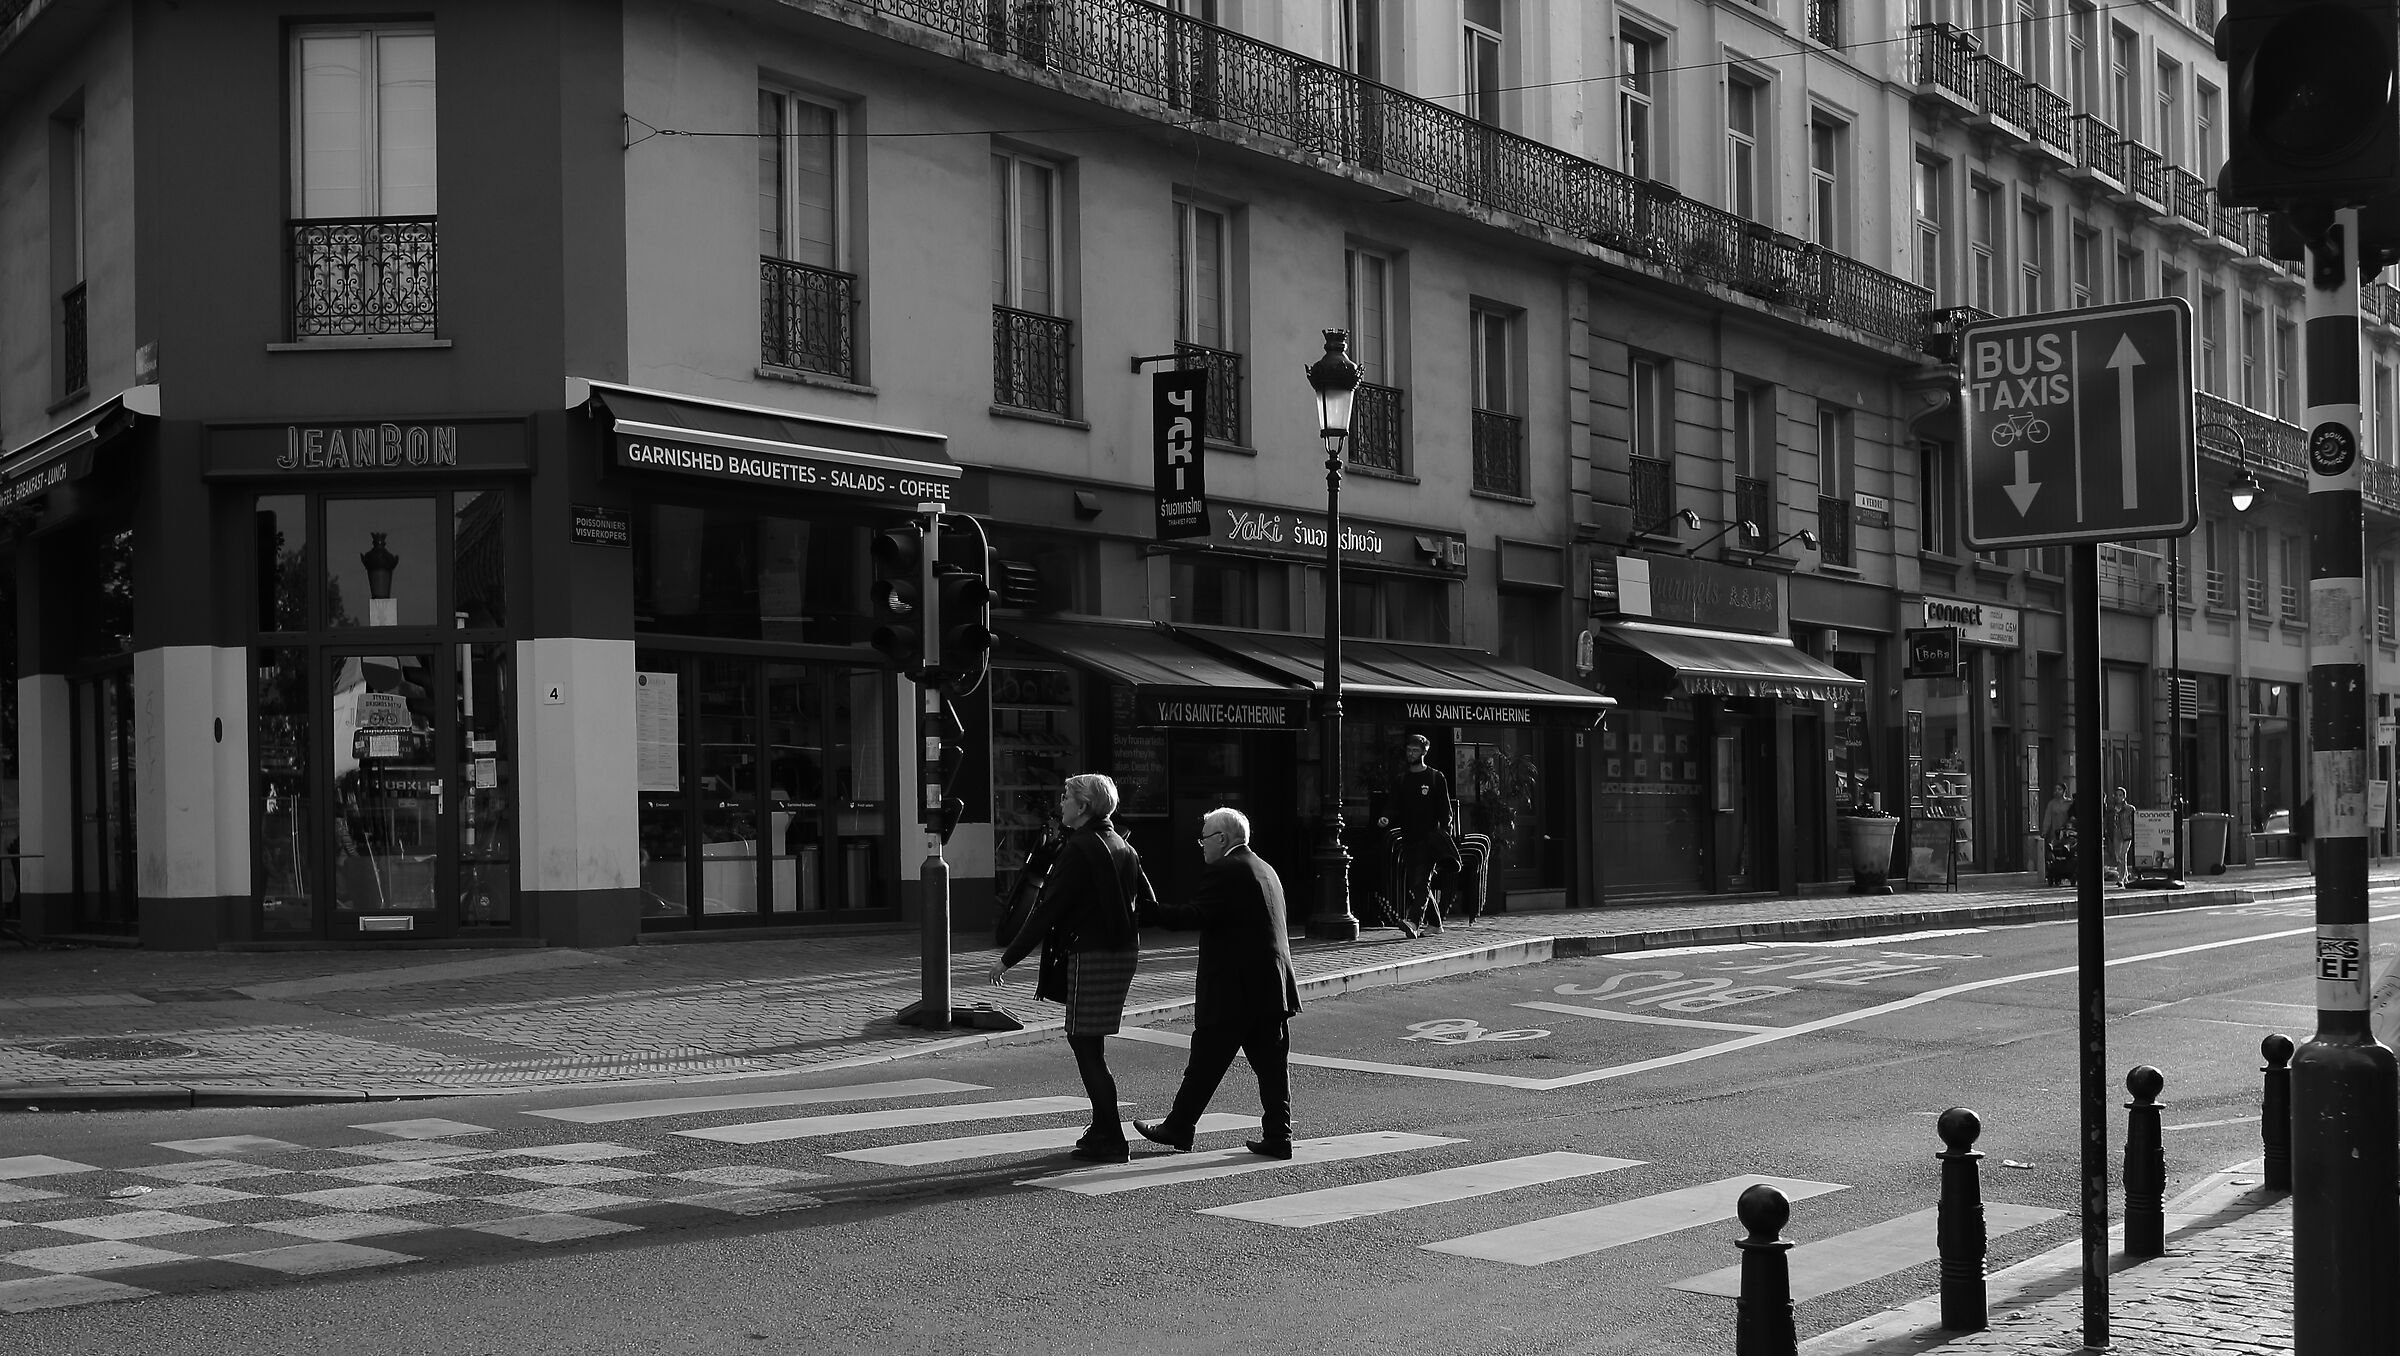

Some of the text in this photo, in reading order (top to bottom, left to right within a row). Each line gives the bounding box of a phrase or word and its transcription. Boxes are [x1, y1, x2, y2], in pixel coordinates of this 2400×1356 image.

[1976, 333, 2062, 379] BUS
[1971, 373, 2070, 412] TAXIS
[16, 472, 44, 501] BREAKFAST
[47, 461, 67, 486] LUNCH
[628, 443, 724, 472] GARNISHED
[728, 456, 817, 484] BAGUETTES
[830, 470, 885, 493] SALADS
[899, 479, 951, 500] COFFEE
[575, 527, 627, 541] VISVERKOPERS
[576, 517, 626, 531] POISSONNIERS
[1227, 509, 1283, 543] Yaki
[549, 687, 559, 700] 4
[1185, 703, 1286, 725] SAINTE-CATHERINE
[1406, 703, 1531, 723] YAKI SAINTE-CATHERINE
